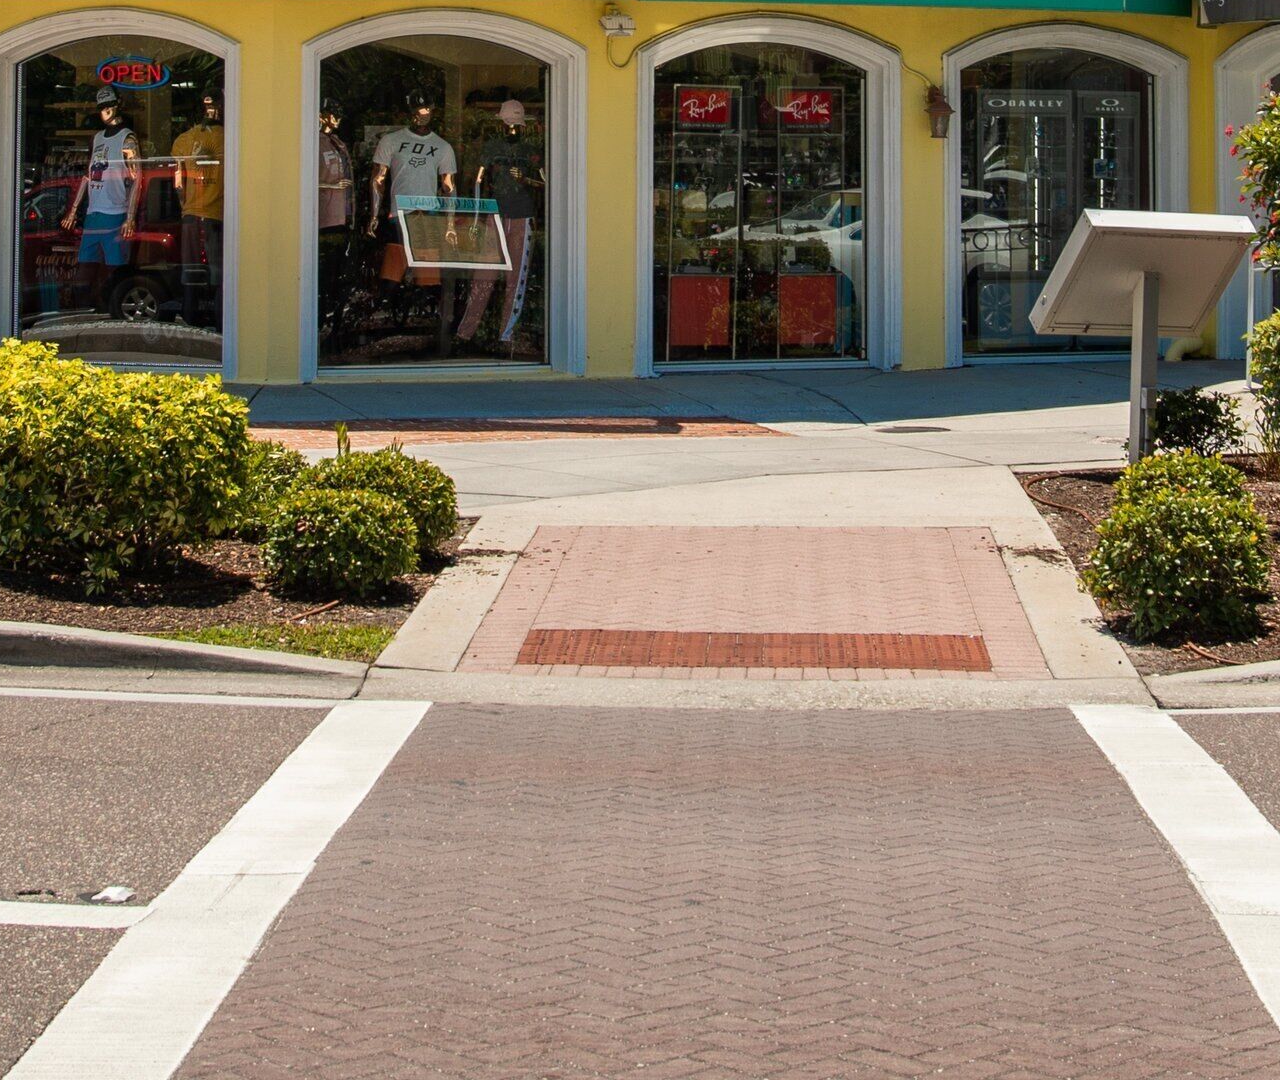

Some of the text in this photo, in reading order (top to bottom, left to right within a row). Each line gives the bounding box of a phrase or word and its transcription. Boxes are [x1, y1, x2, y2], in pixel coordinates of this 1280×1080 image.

[100, 64, 162, 84] OPEN
[1008, 99, 1063, 108] OAKLEY
[398, 142, 439, 157] FOX
